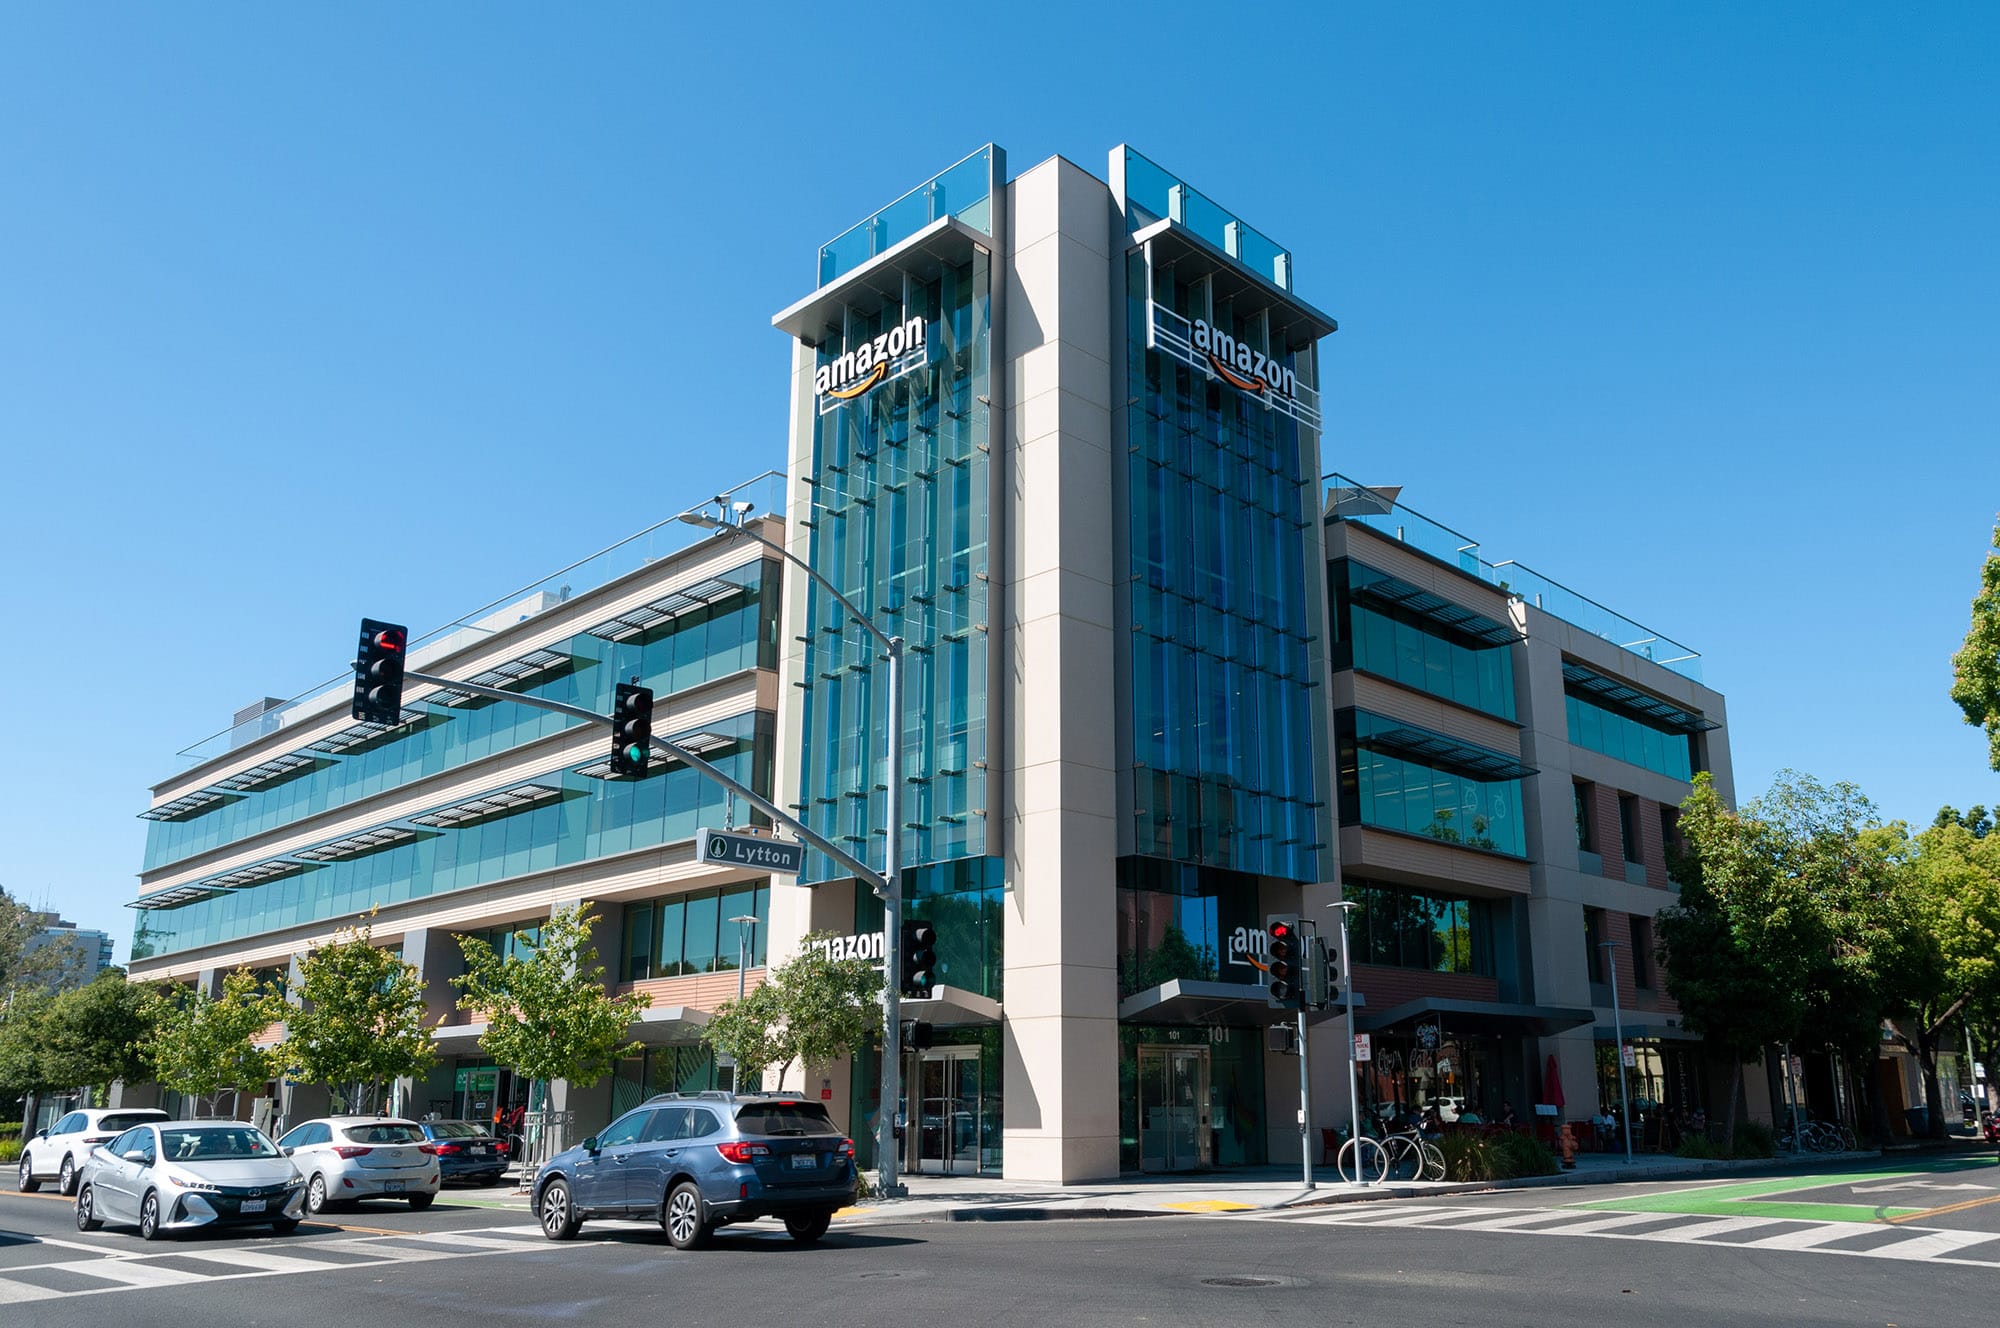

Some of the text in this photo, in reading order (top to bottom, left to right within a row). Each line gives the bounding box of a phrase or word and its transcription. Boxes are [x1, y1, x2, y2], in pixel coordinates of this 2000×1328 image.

[815, 316, 922, 395] amazon
[1194, 319, 1296, 398] amazon
[735, 843, 790, 863] Lytton
[1168, 1030, 1180, 1040] 101
[1208, 1026, 1230, 1043] 101
